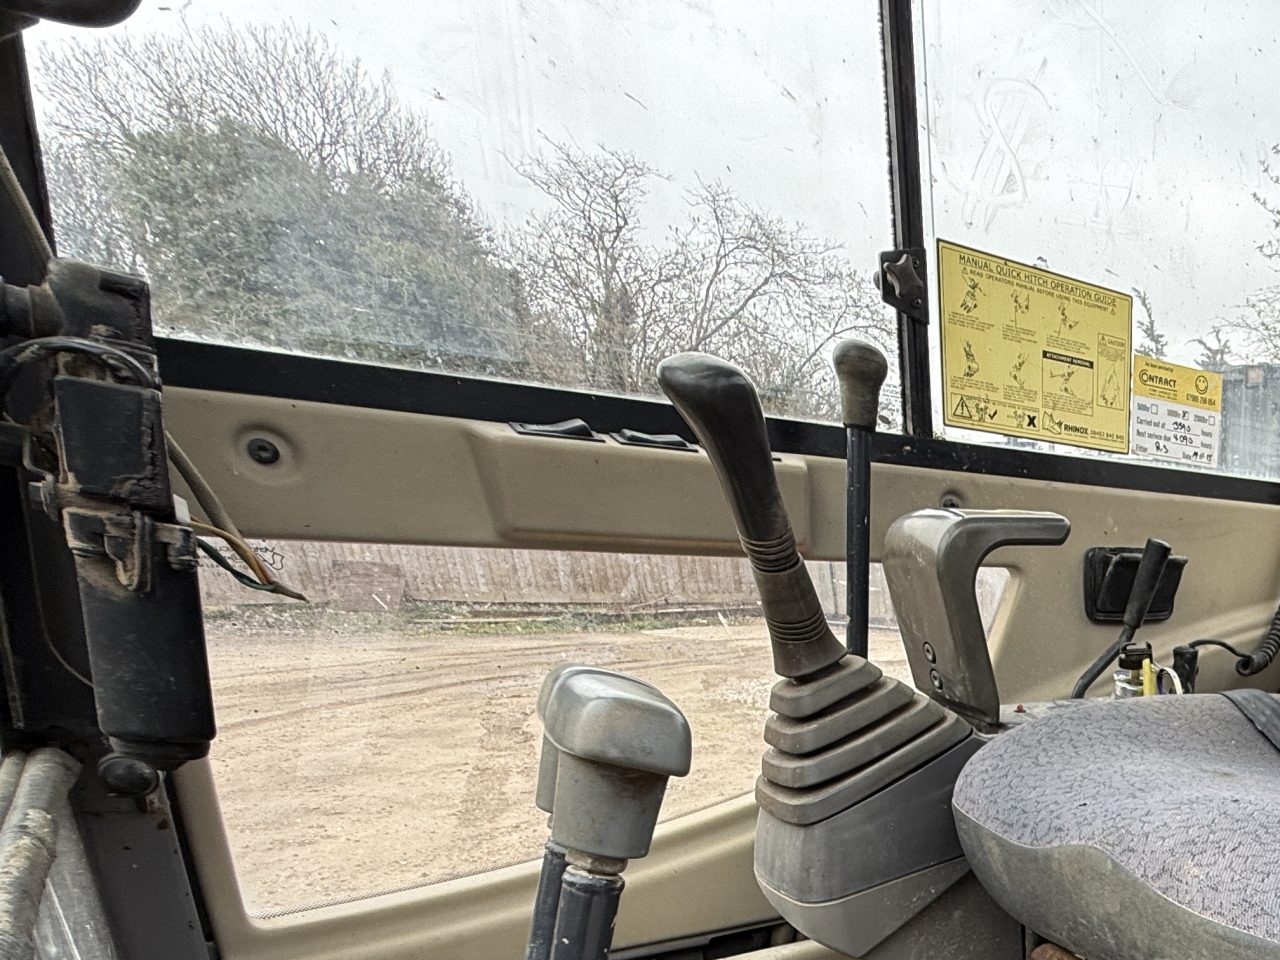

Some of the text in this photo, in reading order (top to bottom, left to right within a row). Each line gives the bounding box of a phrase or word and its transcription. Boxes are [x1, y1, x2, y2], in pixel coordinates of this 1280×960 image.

[959, 254, 1117, 306] MANUAL QUICK HITCH OPERATION GUIDE
[970, 269, 1109, 312] READ OPERATORS MANUAL BEFORE USING THIS EQUIPMENT
[1107, 338, 1125, 348] CAUTION
[1046, 352, 1091, 367] ATTACHMENT REMOVAL
[1139, 369, 1177, 389] CONTRACT
[1064, 424, 1089, 435] RHINOX
[1136, 416, 1152, 426] Carried
[1201, 428, 1213, 438] hours
[1136, 429, 1146, 438] Next
[1201, 440, 1212, 449] hours
[1136, 443, 1148, 453] Fitter
[1182, 452, 1192, 460] Date
